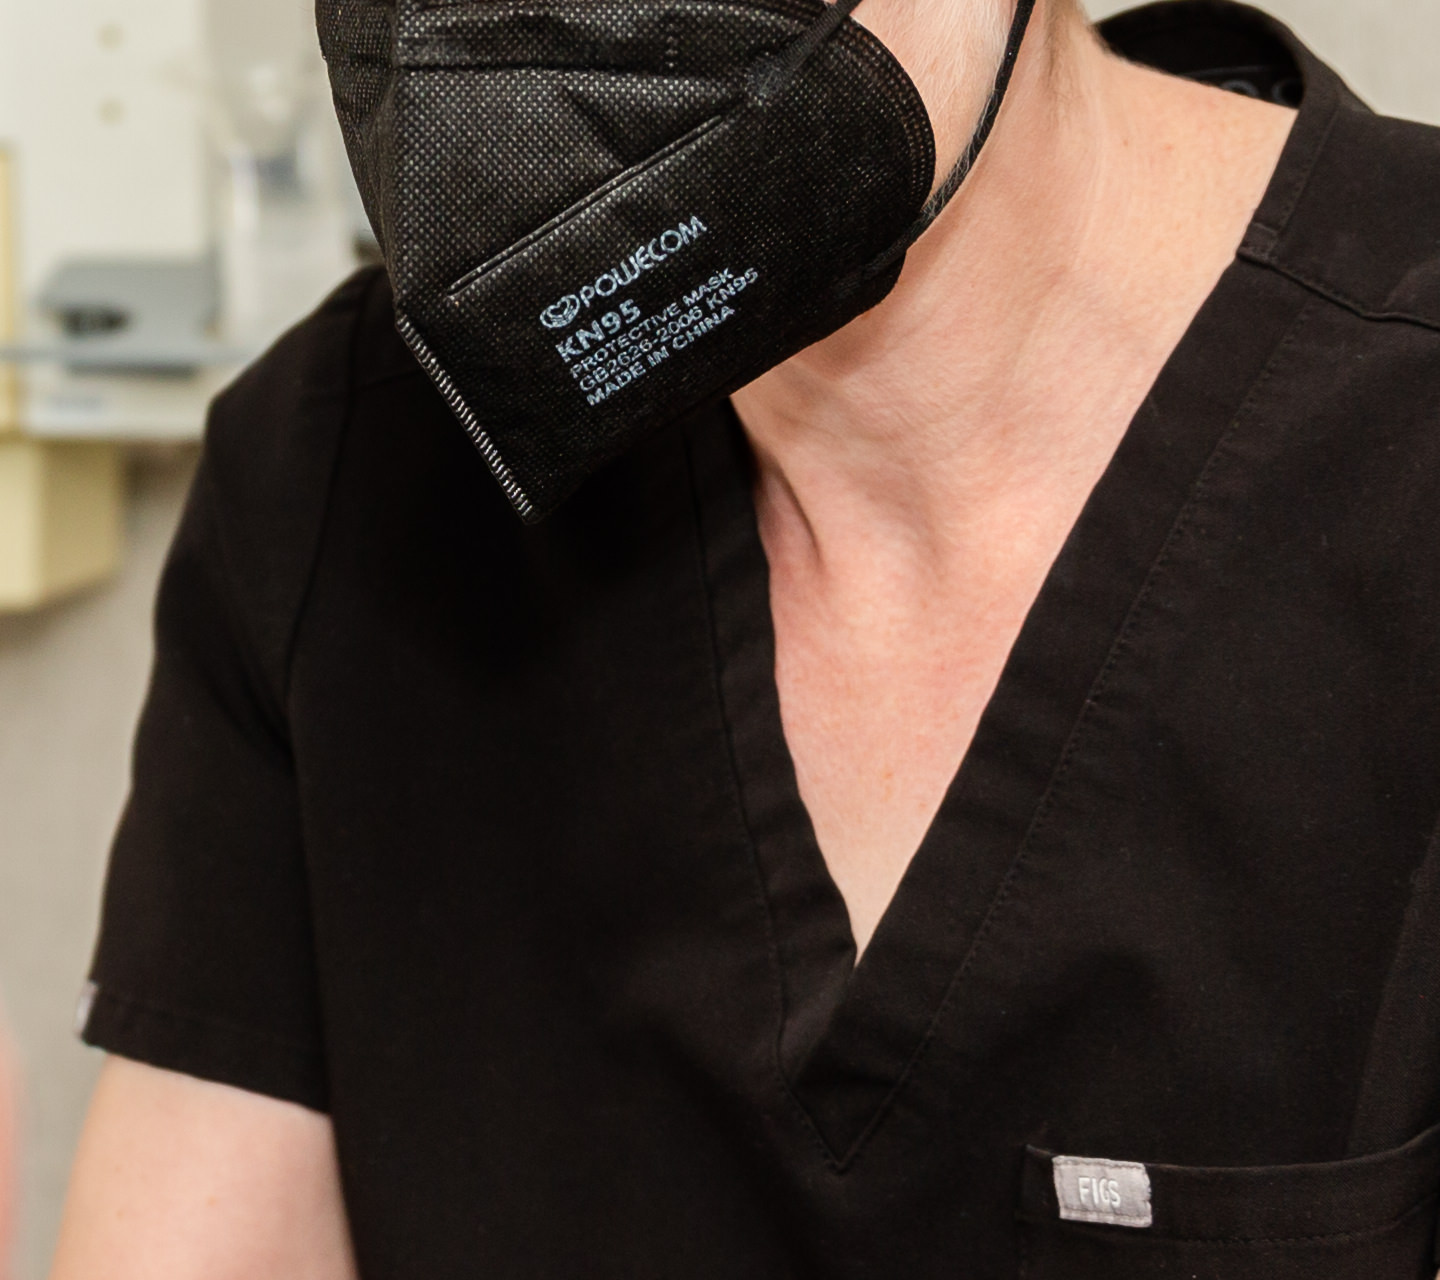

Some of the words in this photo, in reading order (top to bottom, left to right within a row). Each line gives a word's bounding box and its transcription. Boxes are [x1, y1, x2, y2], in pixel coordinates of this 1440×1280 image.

[580, 216, 707, 307] POWECOM
[556, 299, 641, 363] KN95
[570, 303, 680, 379] PROTECTIVE
[683, 268, 733, 307] MASK
[580, 306, 703, 391] GB2626-2006
[706, 268, 758, 310] KN95
[587, 361, 646, 406] MADE
[647, 345, 669, 367] IN
[673, 306, 735, 349] CHINA
[1078, 1177, 1121, 1208] FIGS
